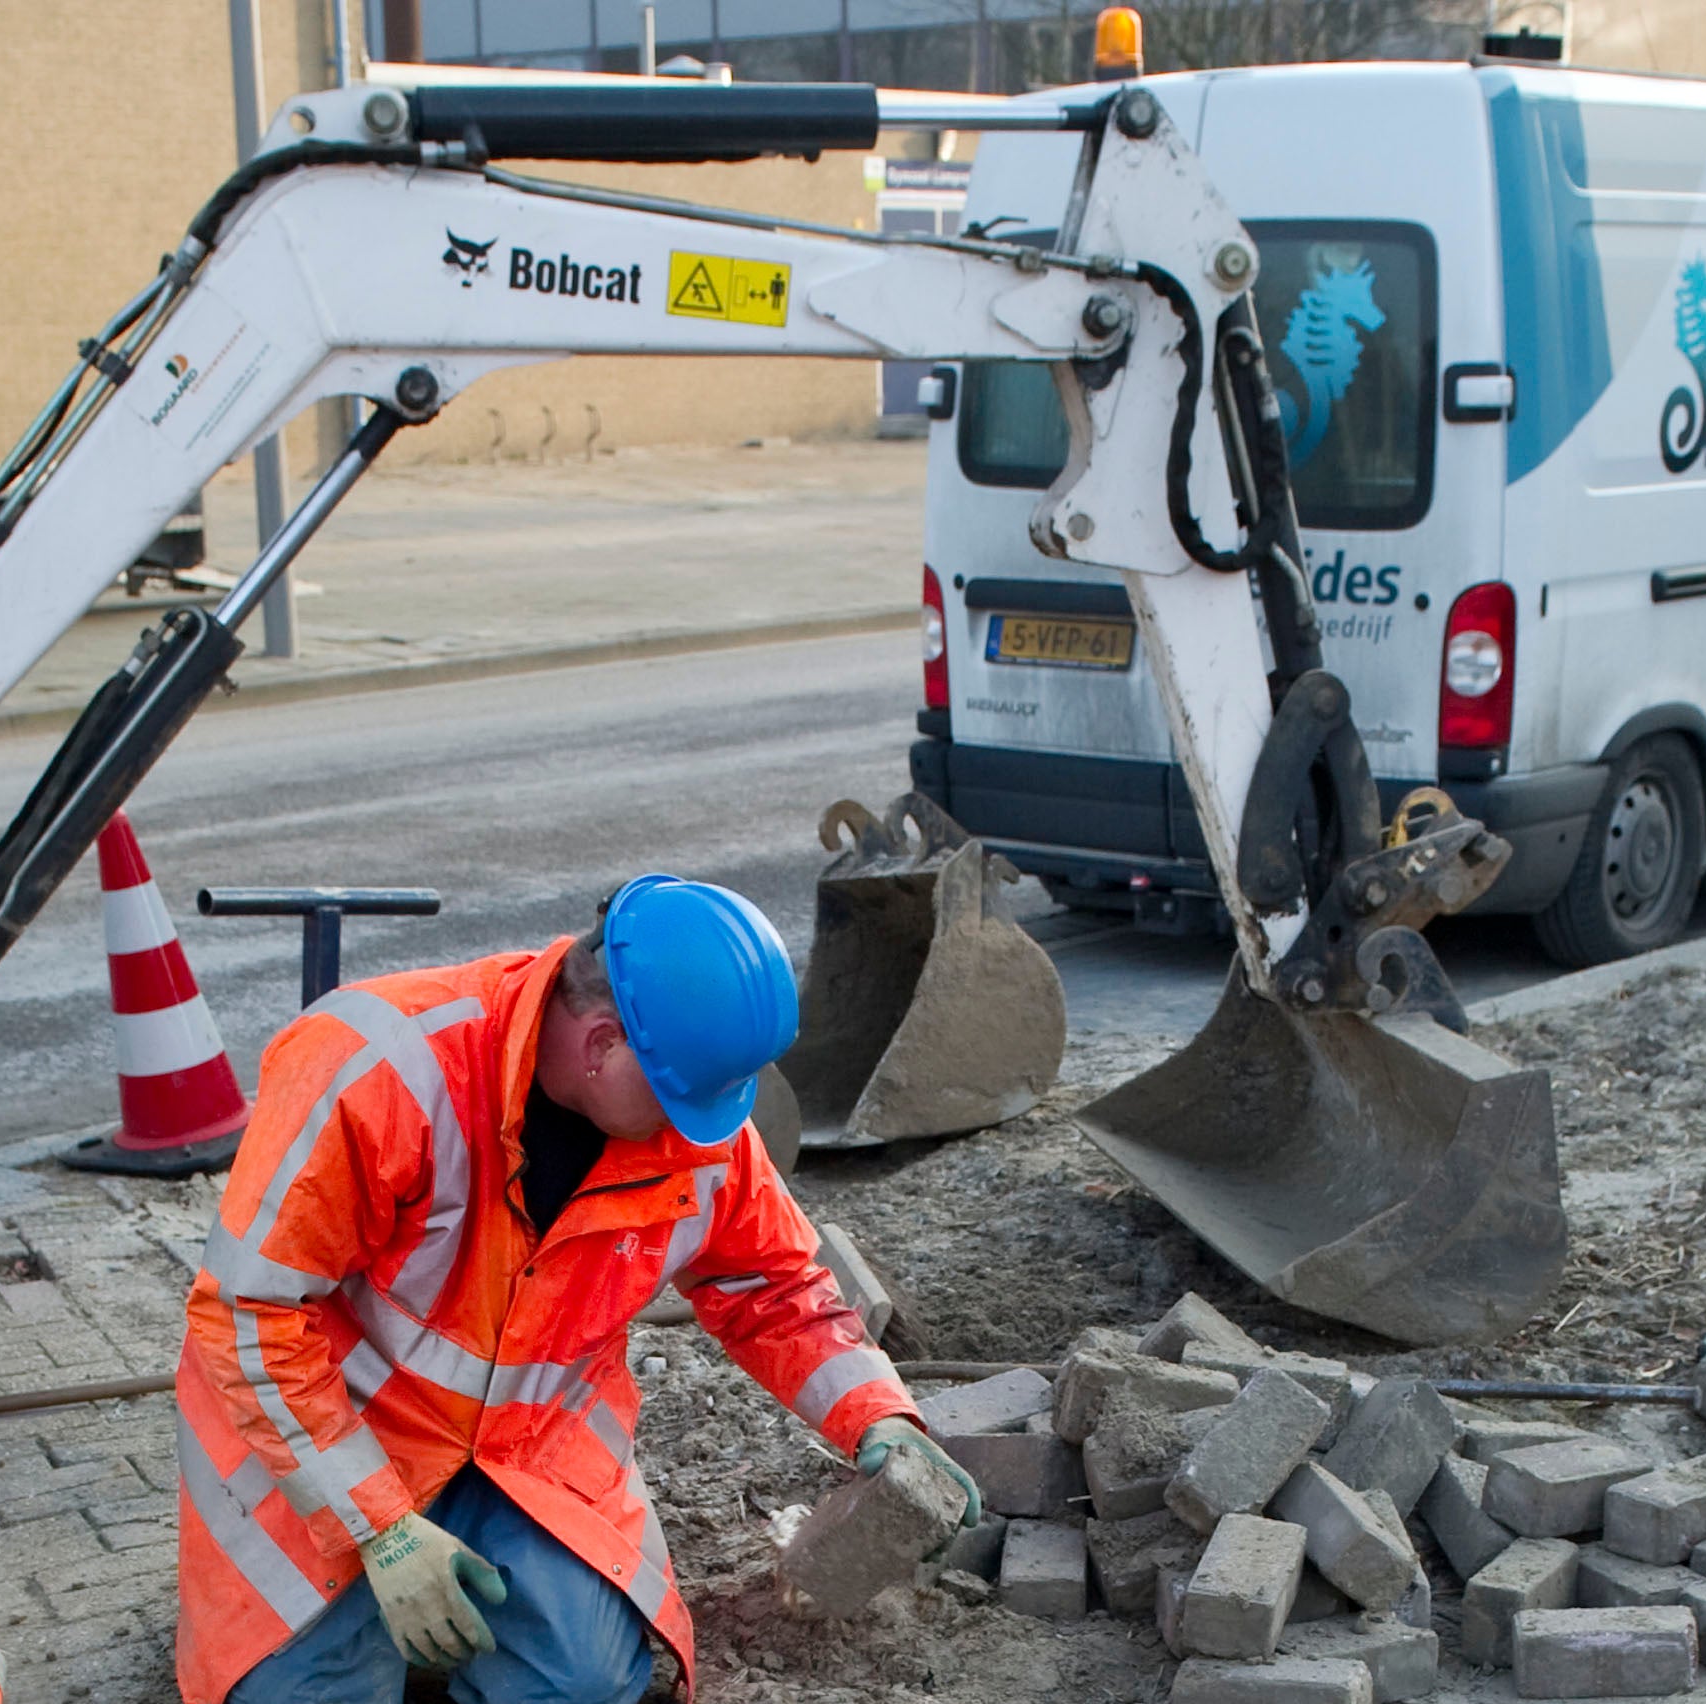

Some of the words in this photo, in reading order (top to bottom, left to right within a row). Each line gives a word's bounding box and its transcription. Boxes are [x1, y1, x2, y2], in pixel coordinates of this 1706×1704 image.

[509, 247, 642, 304] Bobcat
[150, 368, 198, 427] BOGAARD
[376, 1535, 423, 1569] SHOWA
